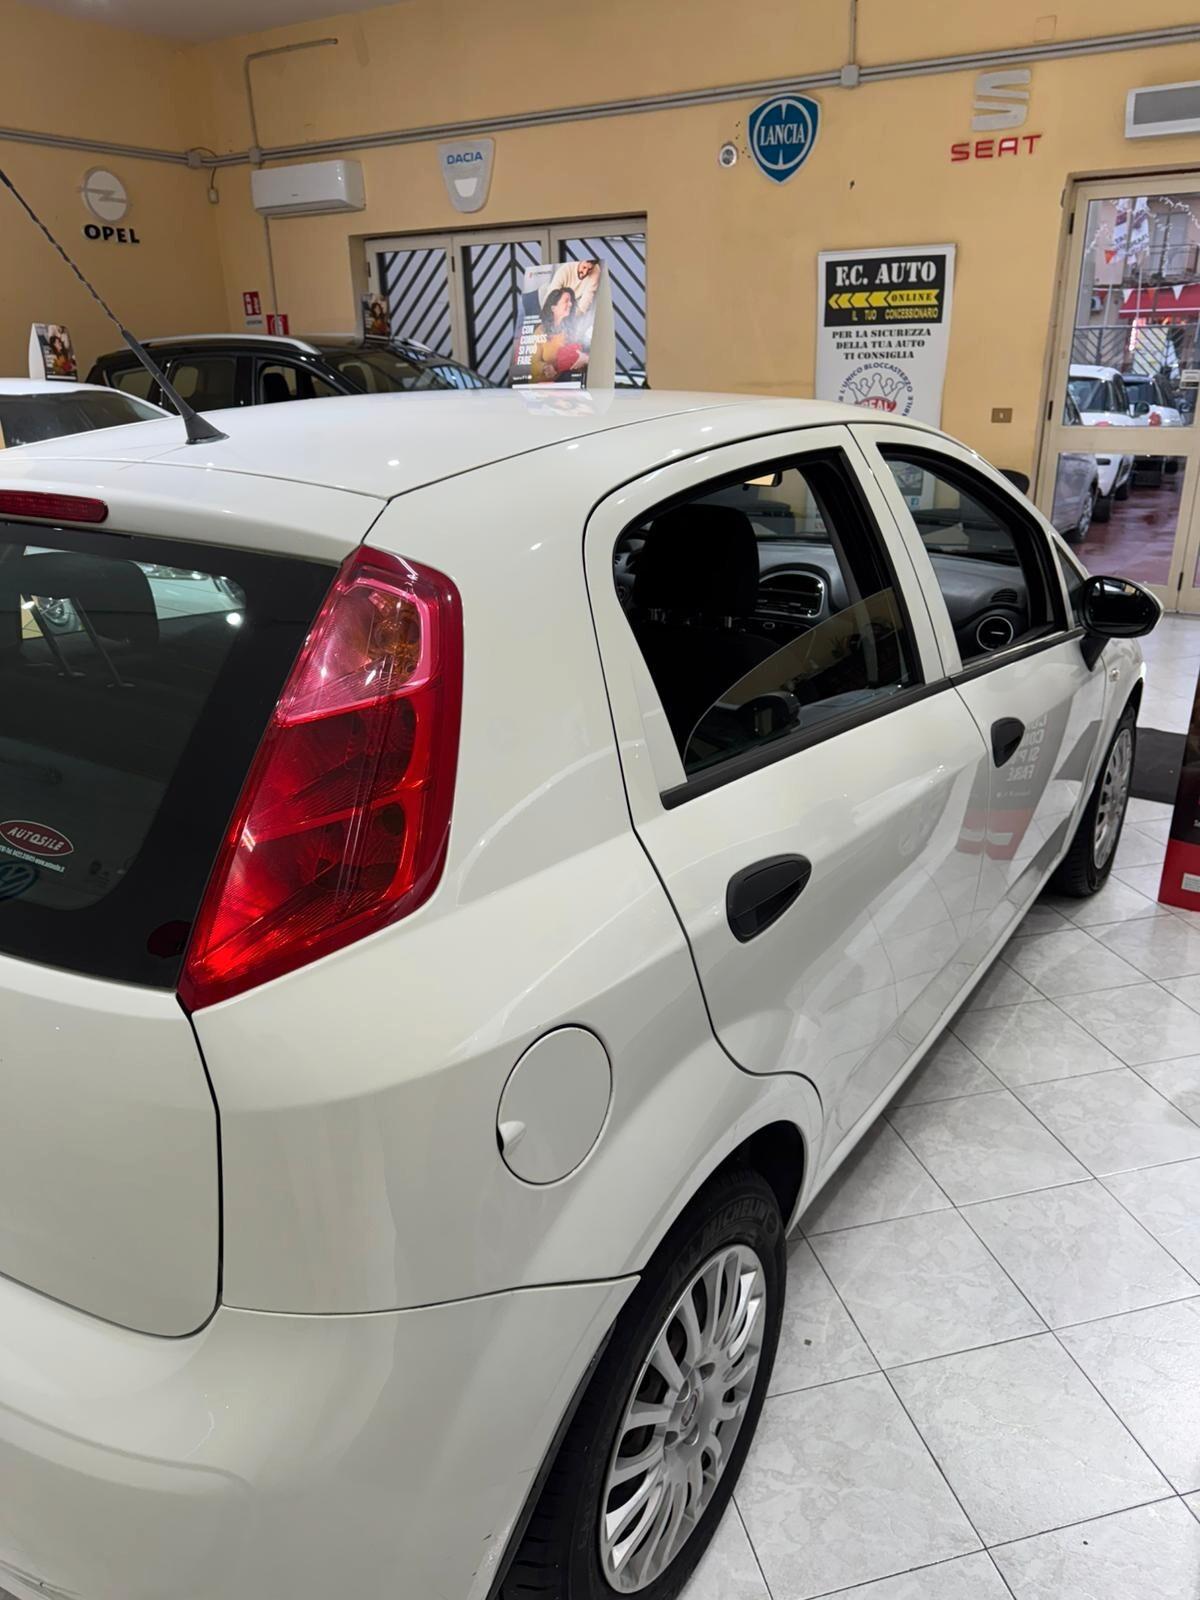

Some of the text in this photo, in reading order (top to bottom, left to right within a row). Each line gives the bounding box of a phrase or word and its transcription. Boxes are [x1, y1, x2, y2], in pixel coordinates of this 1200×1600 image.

[760, 123, 806, 146] LANCIA
[951, 134, 1042, 162] SEAT
[447, 152, 483, 165] DACIA
[84, 224, 140, 244] OPEL
[835, 261, 936, 286] F.C. AUTO
[891, 292, 932, 302] ONLINE
[885, 307, 938, 320] CONCESSIONARIO
[832, 328, 931, 339] PER LA SICUREZZA
[836, 339, 925, 350] DELLA TUA AUTO
[843, 351, 914, 360] TI CONSIGLIA
[7, 827, 64, 850] AUTOSILE
